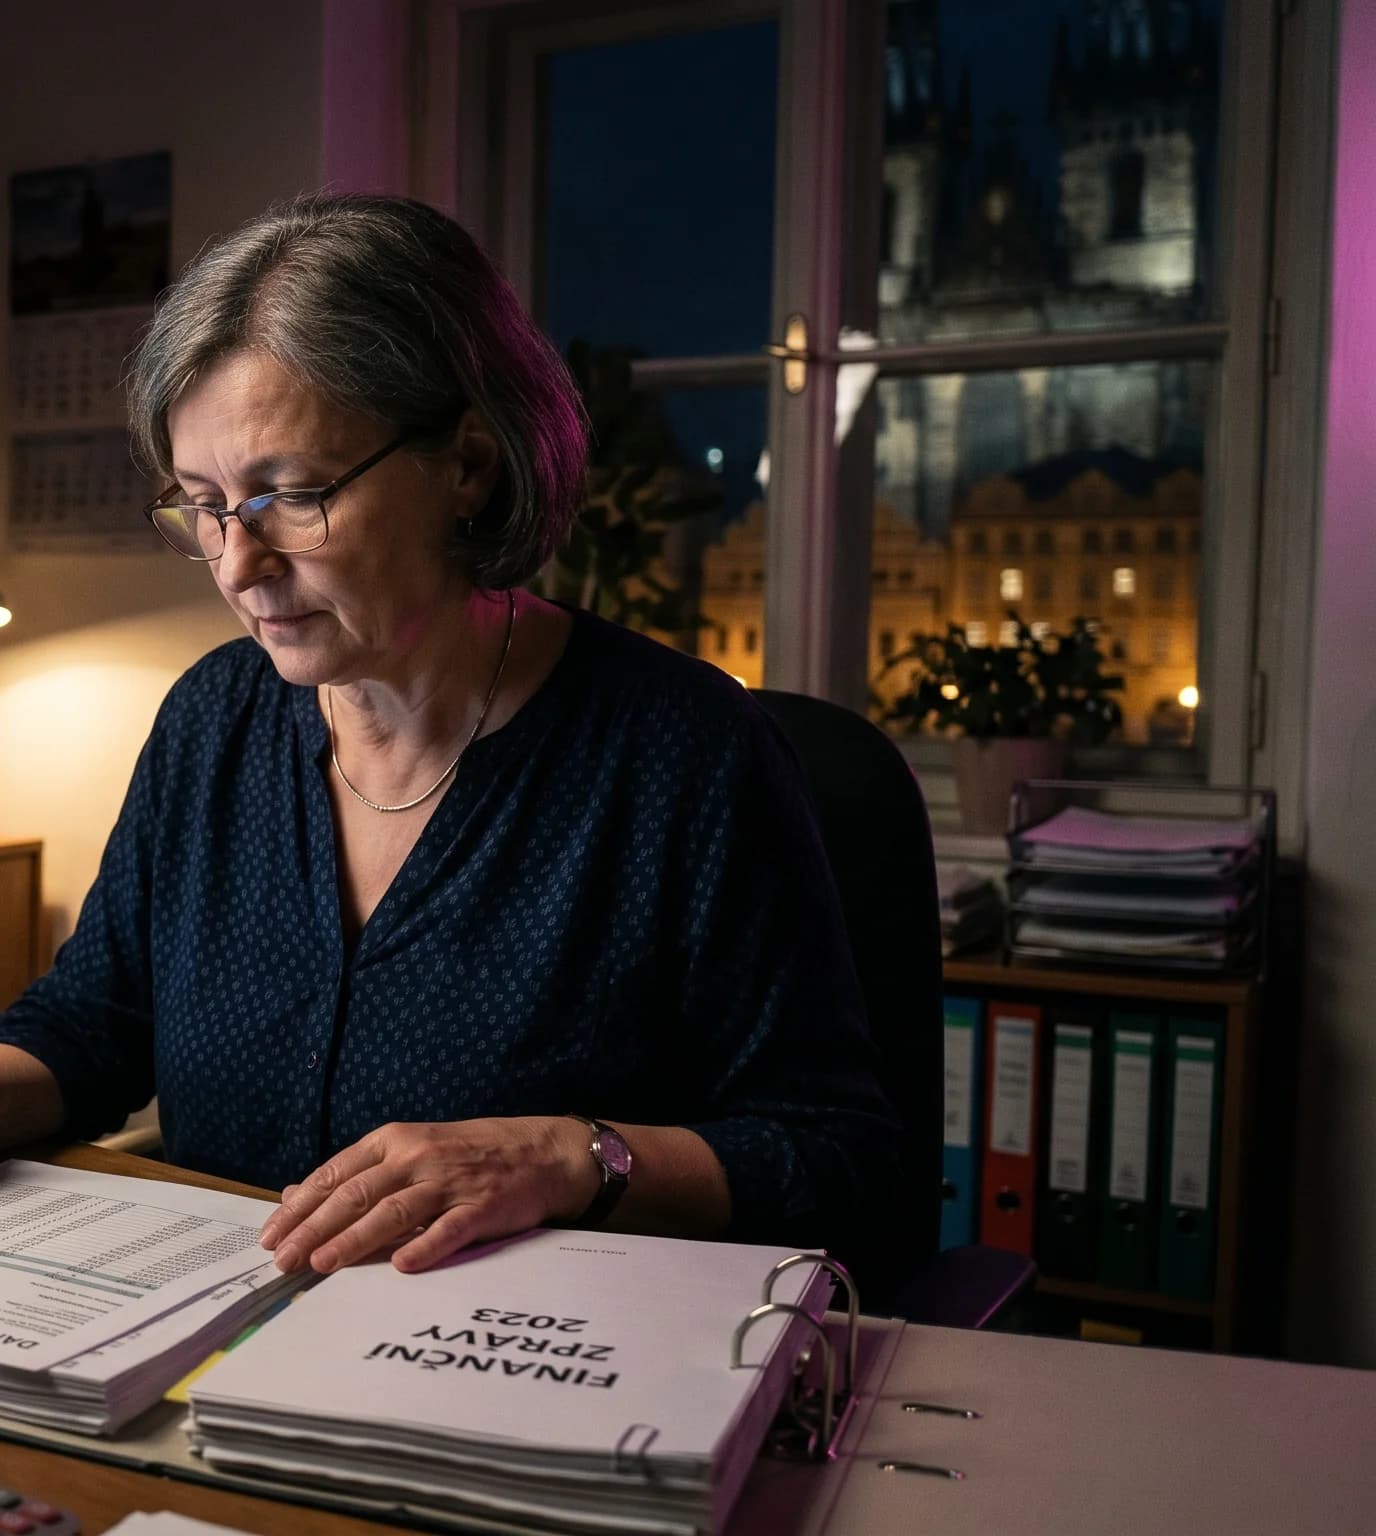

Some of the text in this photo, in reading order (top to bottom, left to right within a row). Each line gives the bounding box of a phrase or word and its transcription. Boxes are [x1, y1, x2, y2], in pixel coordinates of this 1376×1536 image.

[471, 1308, 590, 1333] 2023
[411, 1325, 616, 1362] ZPRÁVY
[363, 1342, 619, 1389] FINANČNÍ
